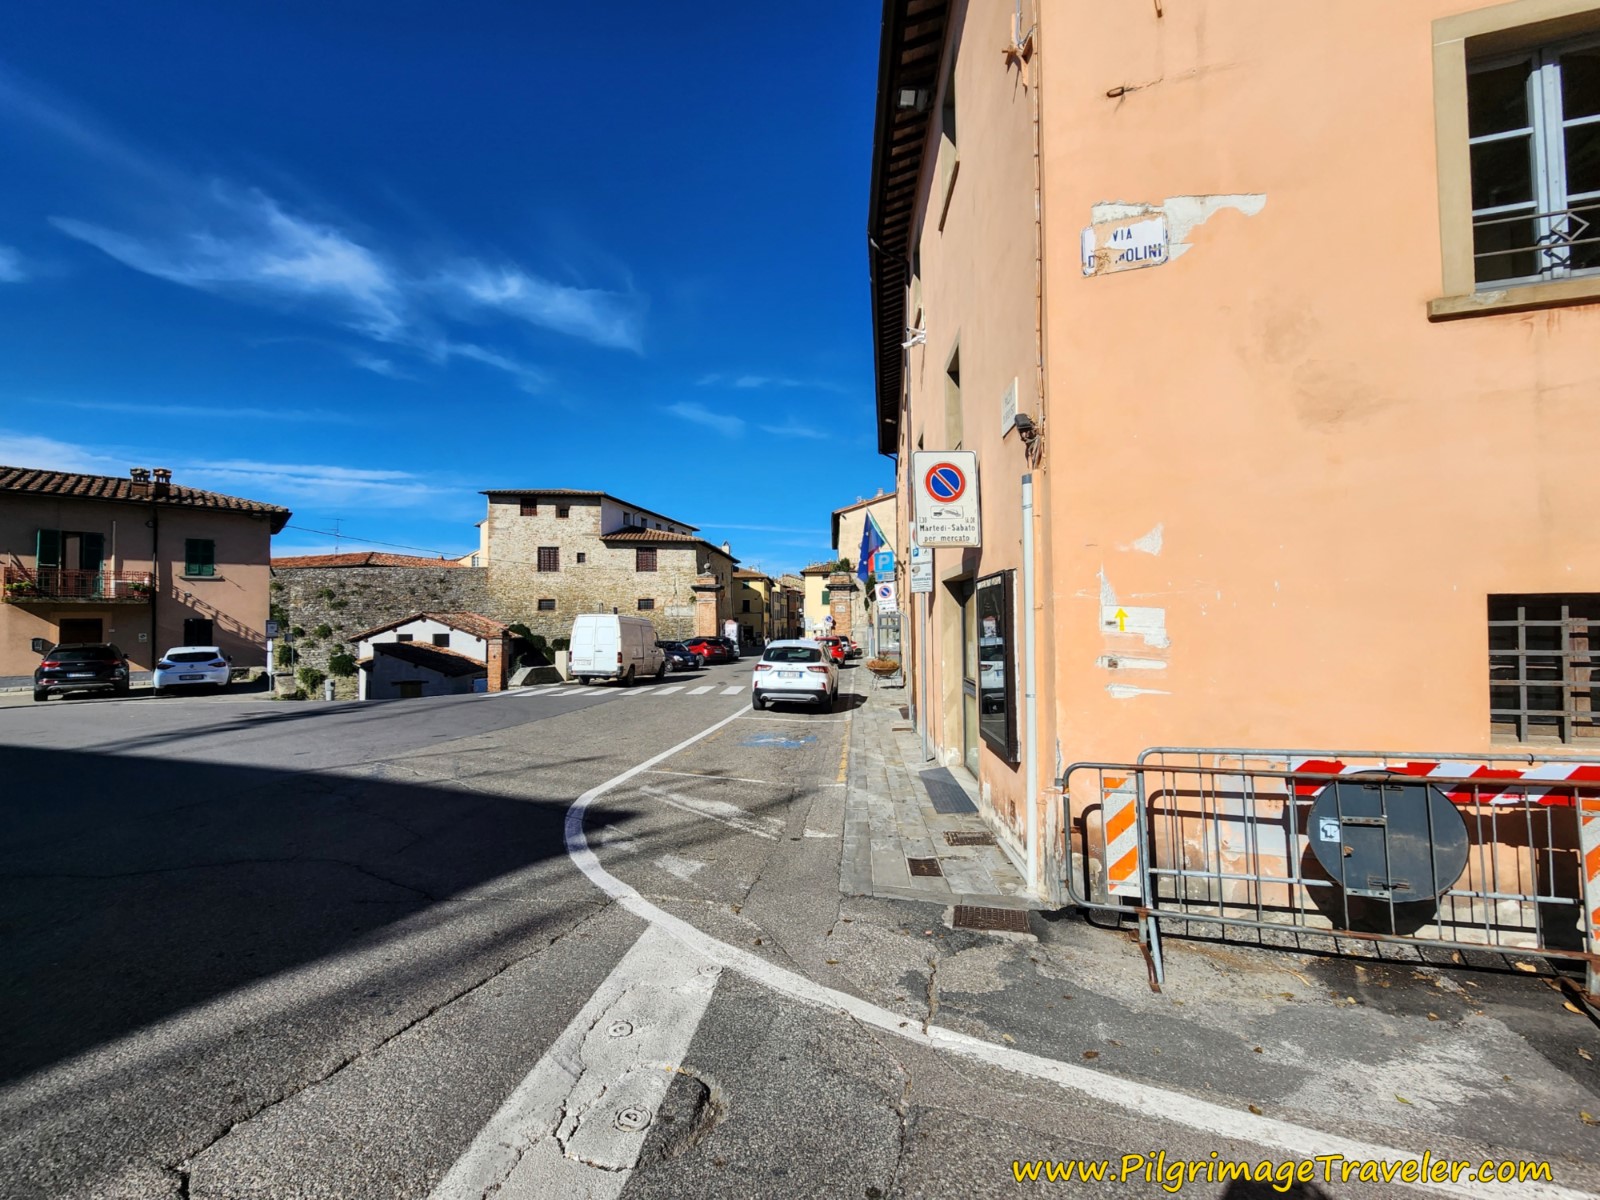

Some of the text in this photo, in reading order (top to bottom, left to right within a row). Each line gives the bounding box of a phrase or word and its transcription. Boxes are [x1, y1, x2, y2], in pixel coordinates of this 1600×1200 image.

[1112, 228, 1133, 242] VIA
[940, 534, 970, 542] mercato
[879, 554, 890, 569] P
